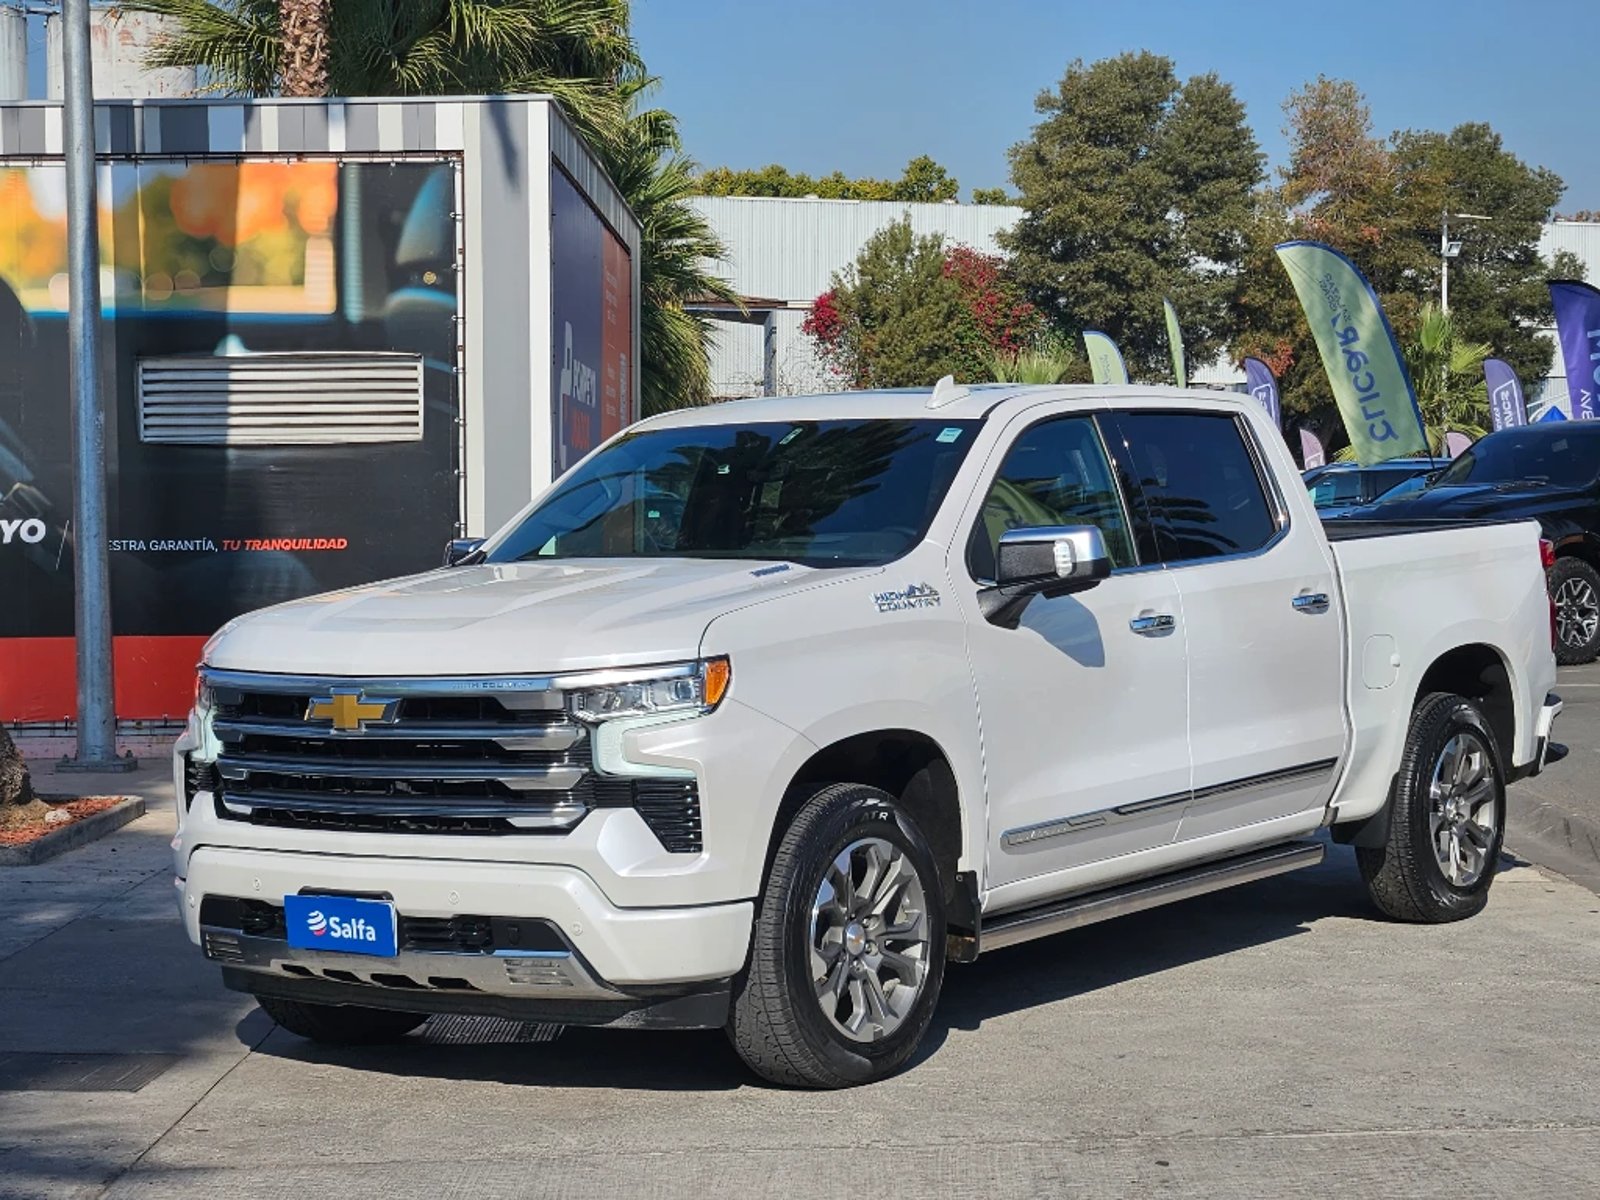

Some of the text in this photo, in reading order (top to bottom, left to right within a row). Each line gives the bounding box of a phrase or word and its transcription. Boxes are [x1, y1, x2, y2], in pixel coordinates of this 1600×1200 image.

[0, 518, 46, 544] YO
[150, 537, 218, 552] GARANTÍA,
[222, 540, 241, 550] TU
[244, 538, 348, 551] TRANQUILIDAD
[329, 917, 376, 942] Salfa
